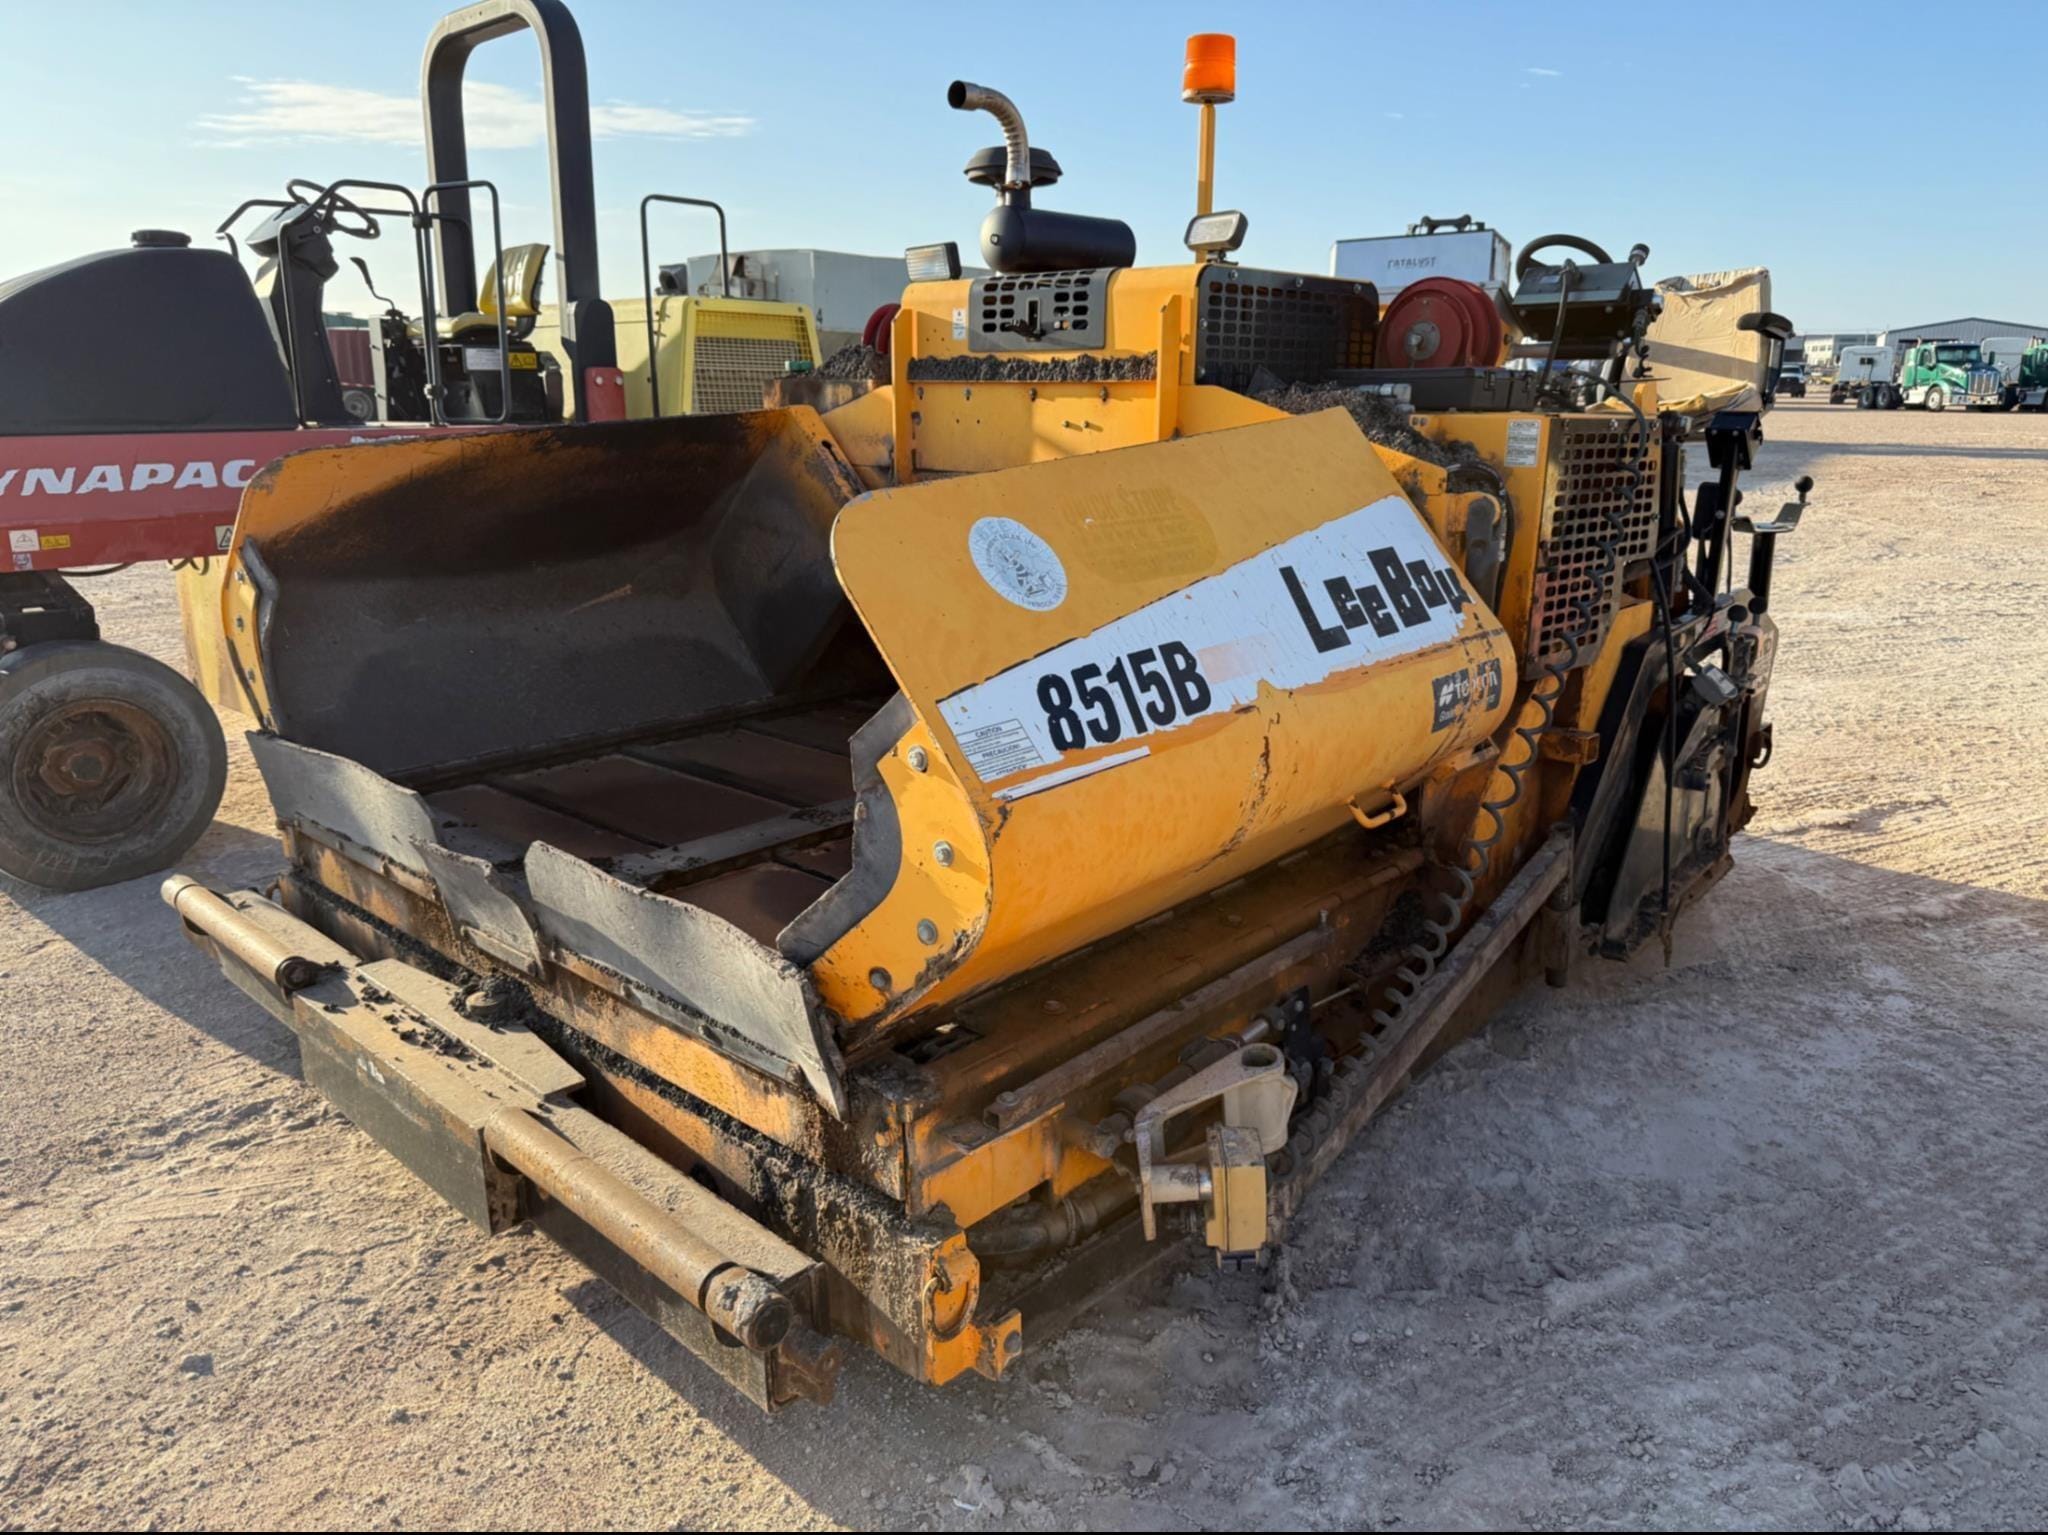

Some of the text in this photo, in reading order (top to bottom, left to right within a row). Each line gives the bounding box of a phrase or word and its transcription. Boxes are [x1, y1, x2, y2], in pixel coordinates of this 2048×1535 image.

[1386, 255, 1437, 269] CATALYST
[1037, 641, 1212, 751] 8515B
[974, 725, 1003, 738] CAUTION
